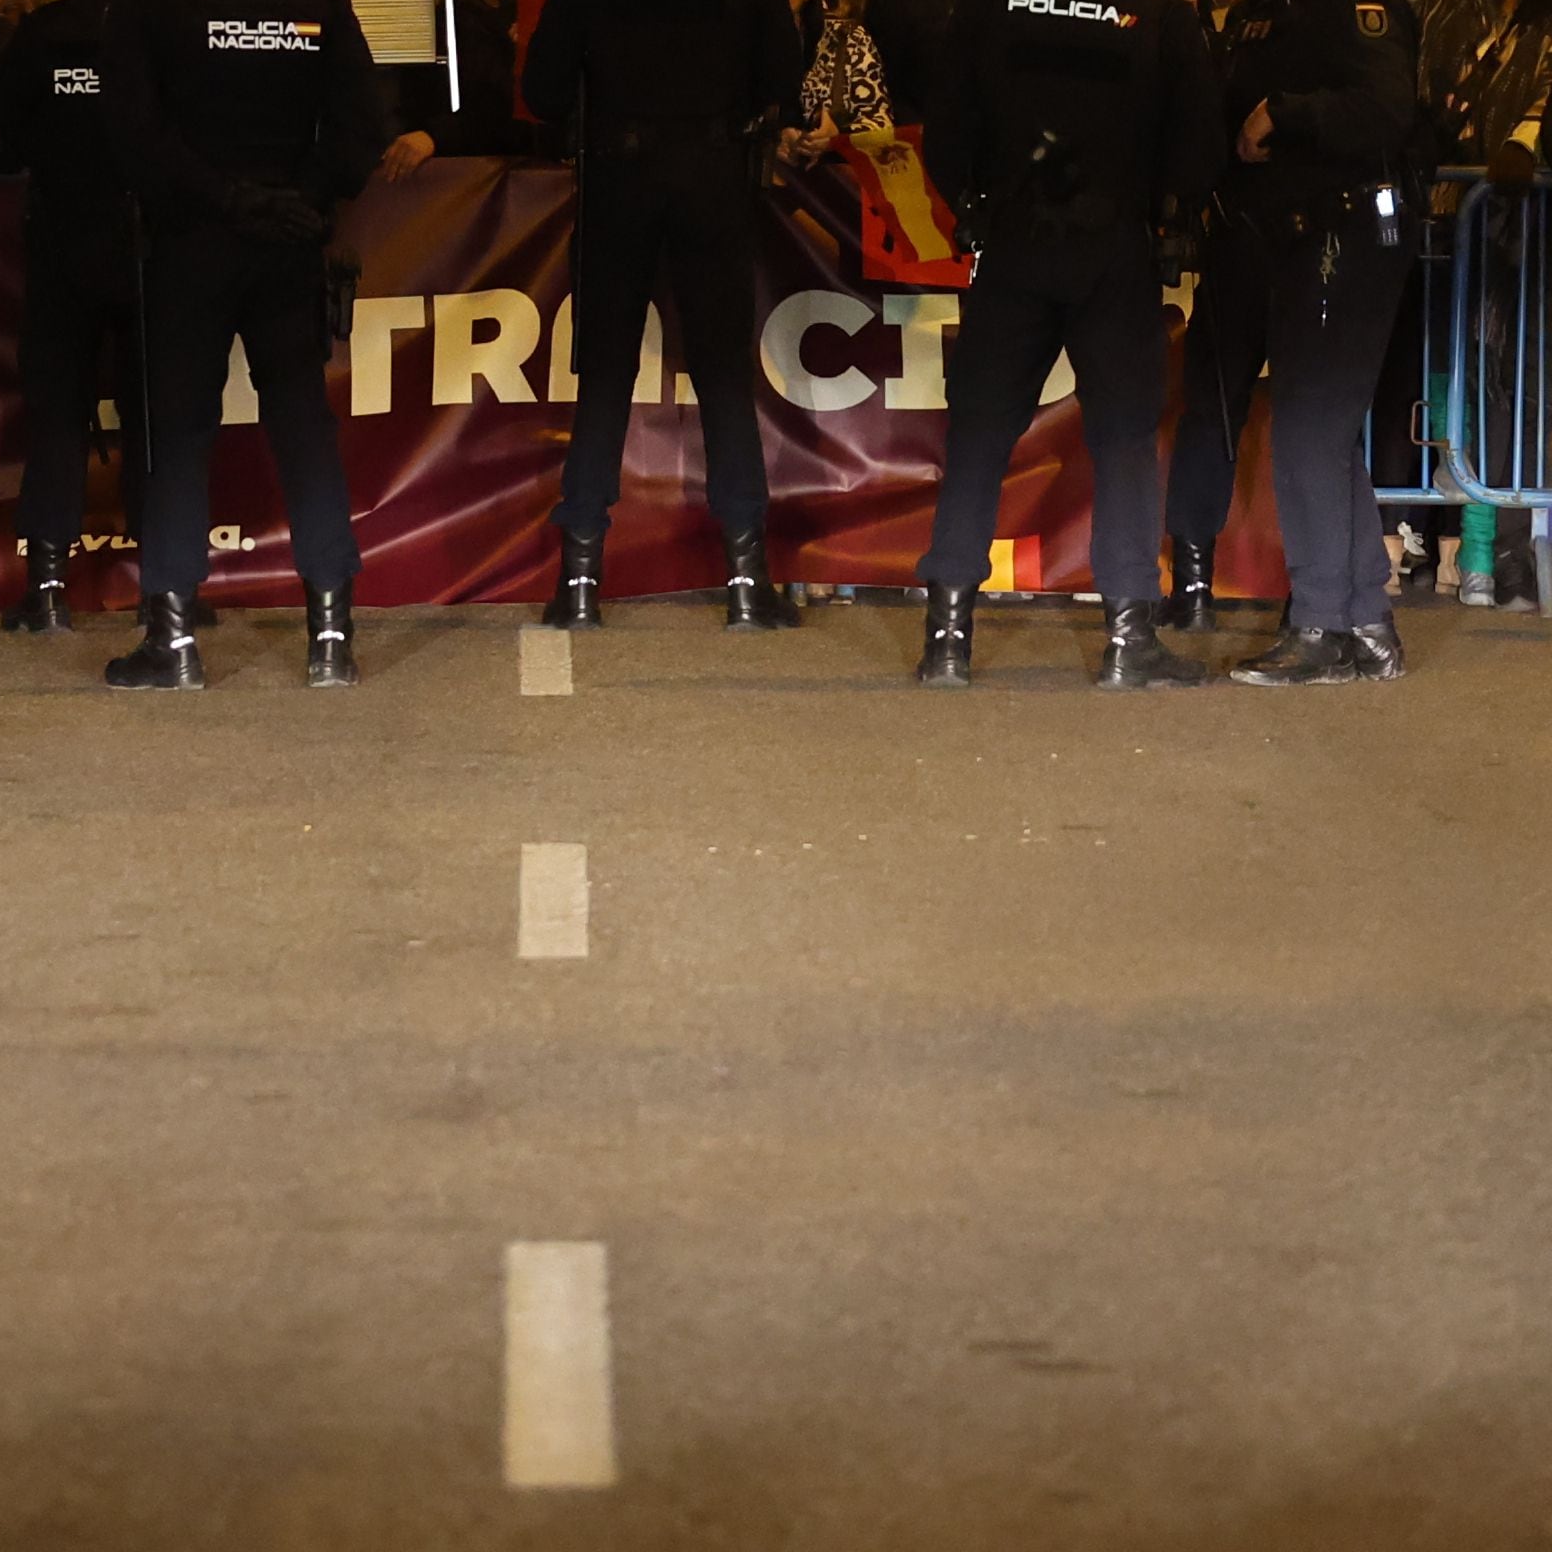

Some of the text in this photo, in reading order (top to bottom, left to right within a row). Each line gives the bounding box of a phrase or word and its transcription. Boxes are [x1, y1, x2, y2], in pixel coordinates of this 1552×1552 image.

[208, 21, 299, 36] POLICIA
[208, 36, 321, 51] NACIONAL
[54, 68, 100, 81] POL
[54, 81, 101, 94] NAC
